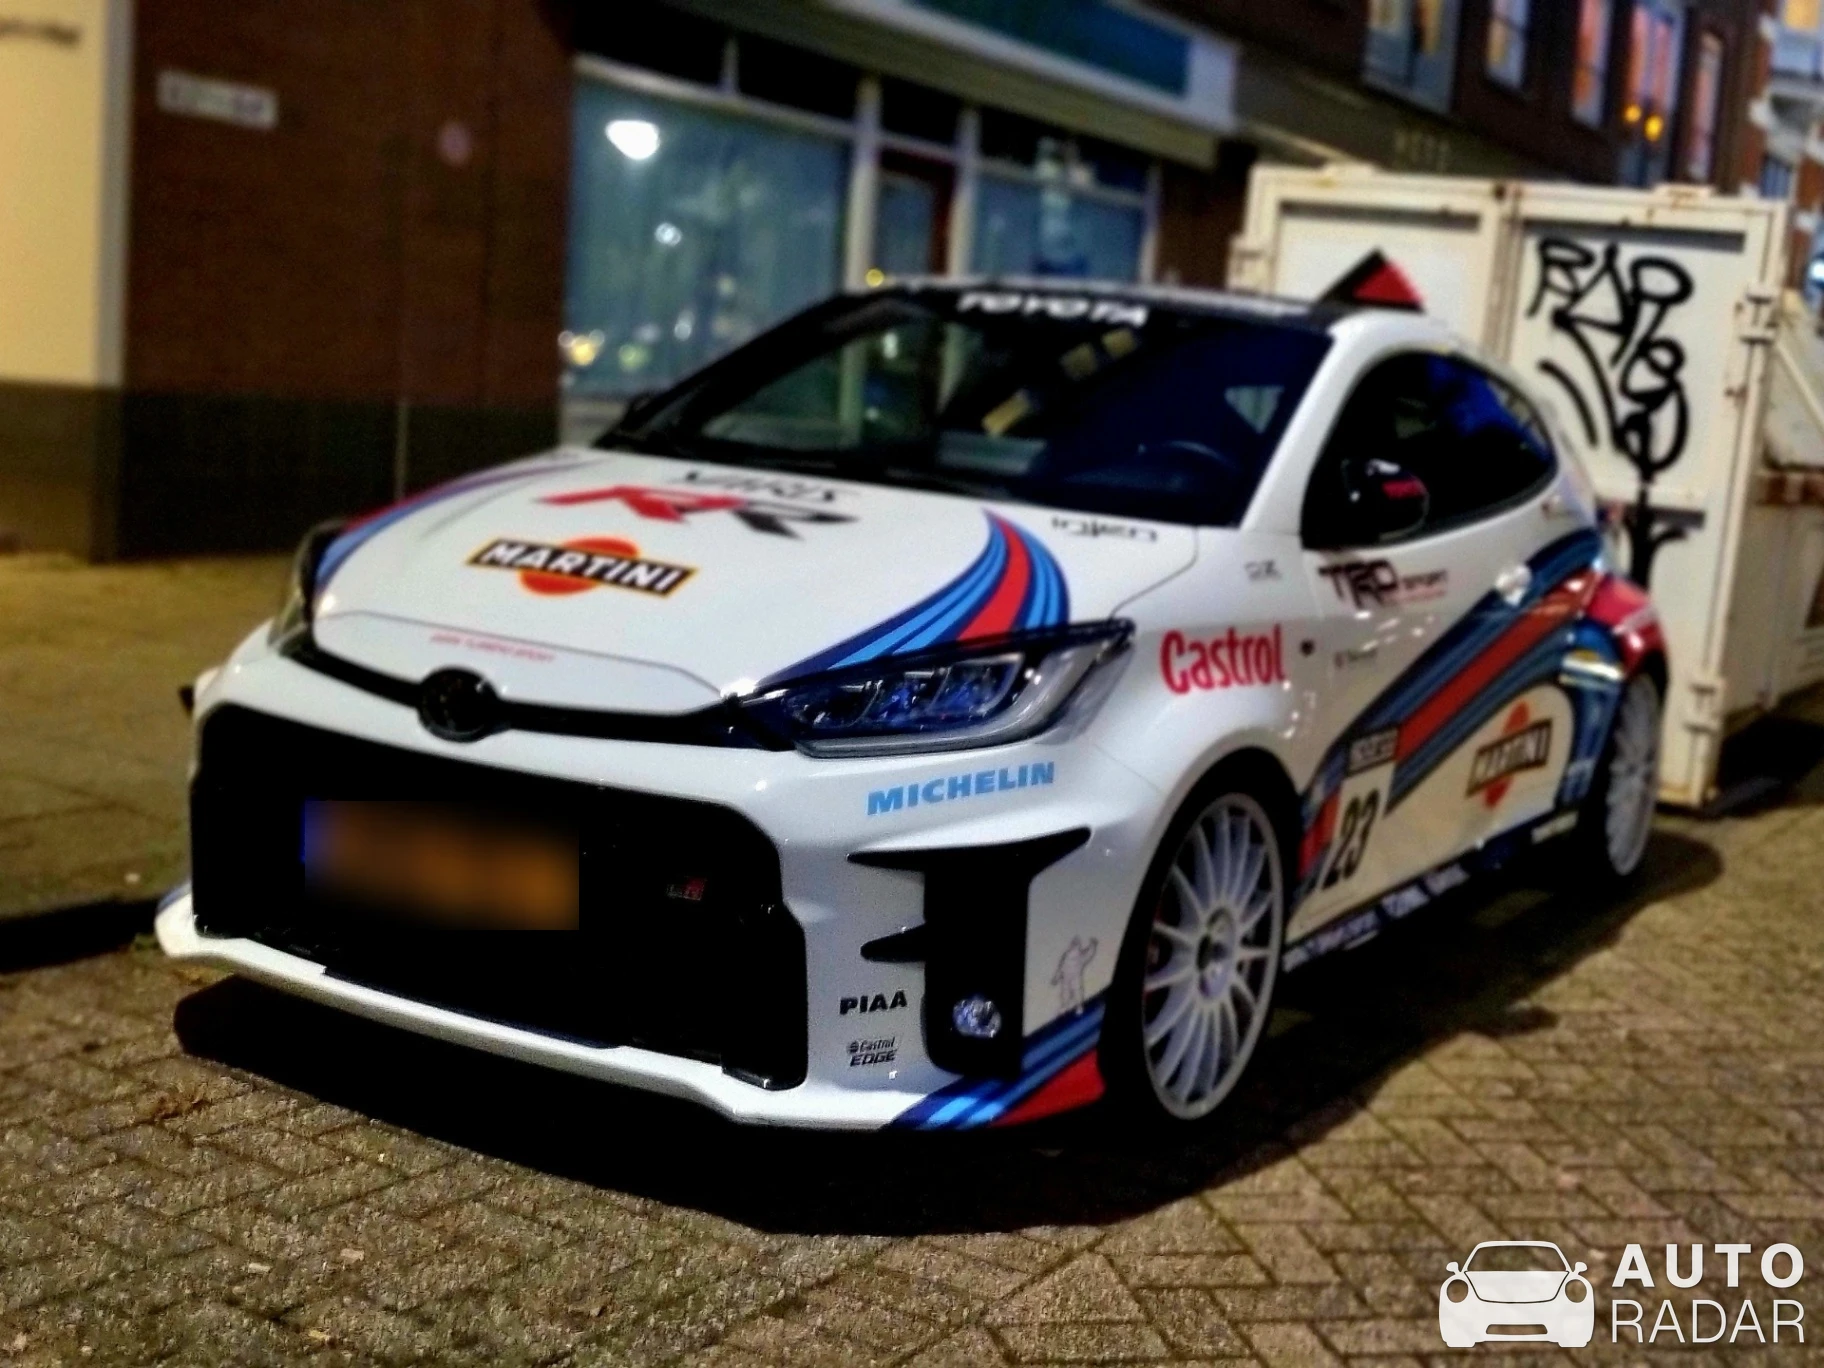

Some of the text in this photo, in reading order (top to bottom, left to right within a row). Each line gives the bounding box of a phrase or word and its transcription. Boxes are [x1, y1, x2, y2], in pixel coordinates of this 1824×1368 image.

[479, 542, 683, 591] MARTINI
[1160, 623, 1286, 695] Castrol
[867, 761, 1055, 816] MICHELIN
[1322, 788, 1380, 890] 23
[839, 989, 908, 1015] PIAA
[849, 1049, 897, 1067] EDGE
